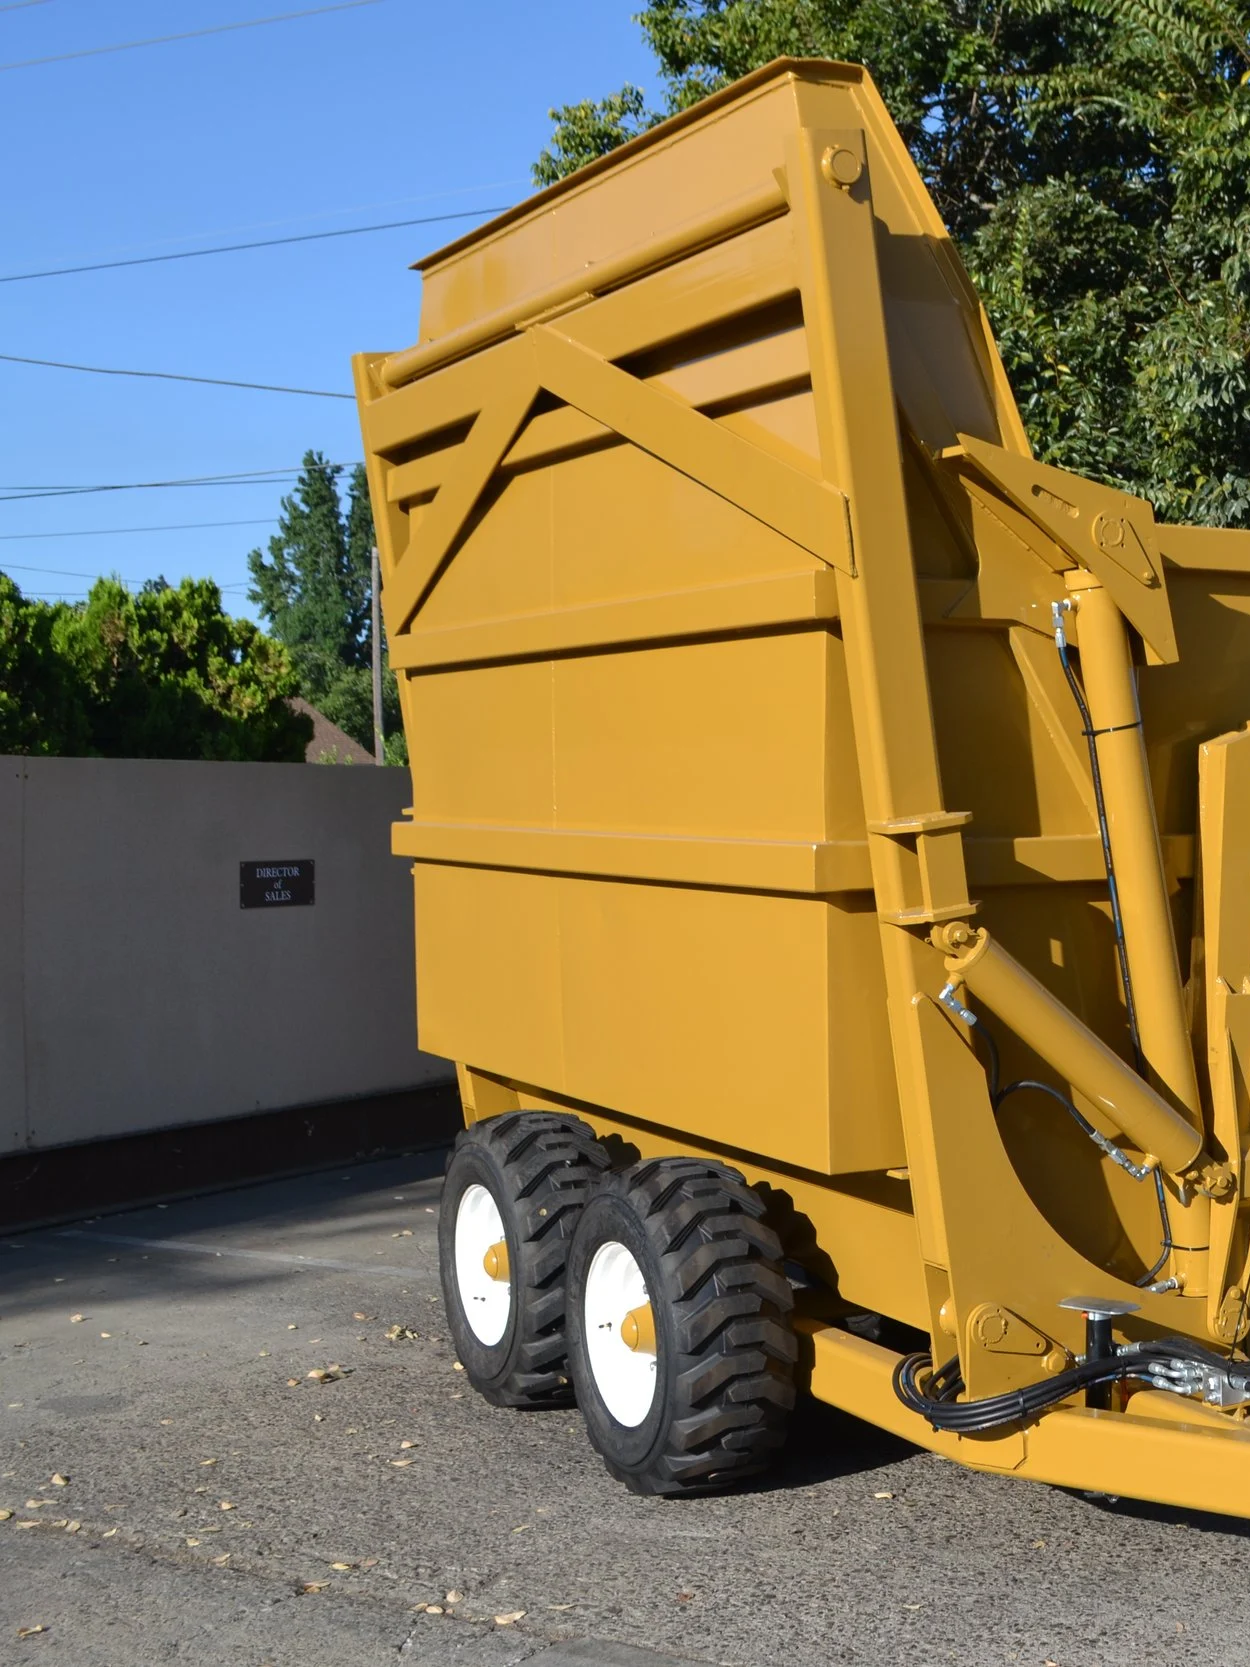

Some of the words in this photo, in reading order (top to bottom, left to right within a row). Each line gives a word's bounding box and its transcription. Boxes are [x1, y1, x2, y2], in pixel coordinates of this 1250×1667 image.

[256, 866, 300, 878] DIRECTOR
[273, 879, 282, 889] of
[265, 890, 291, 901] SALES
